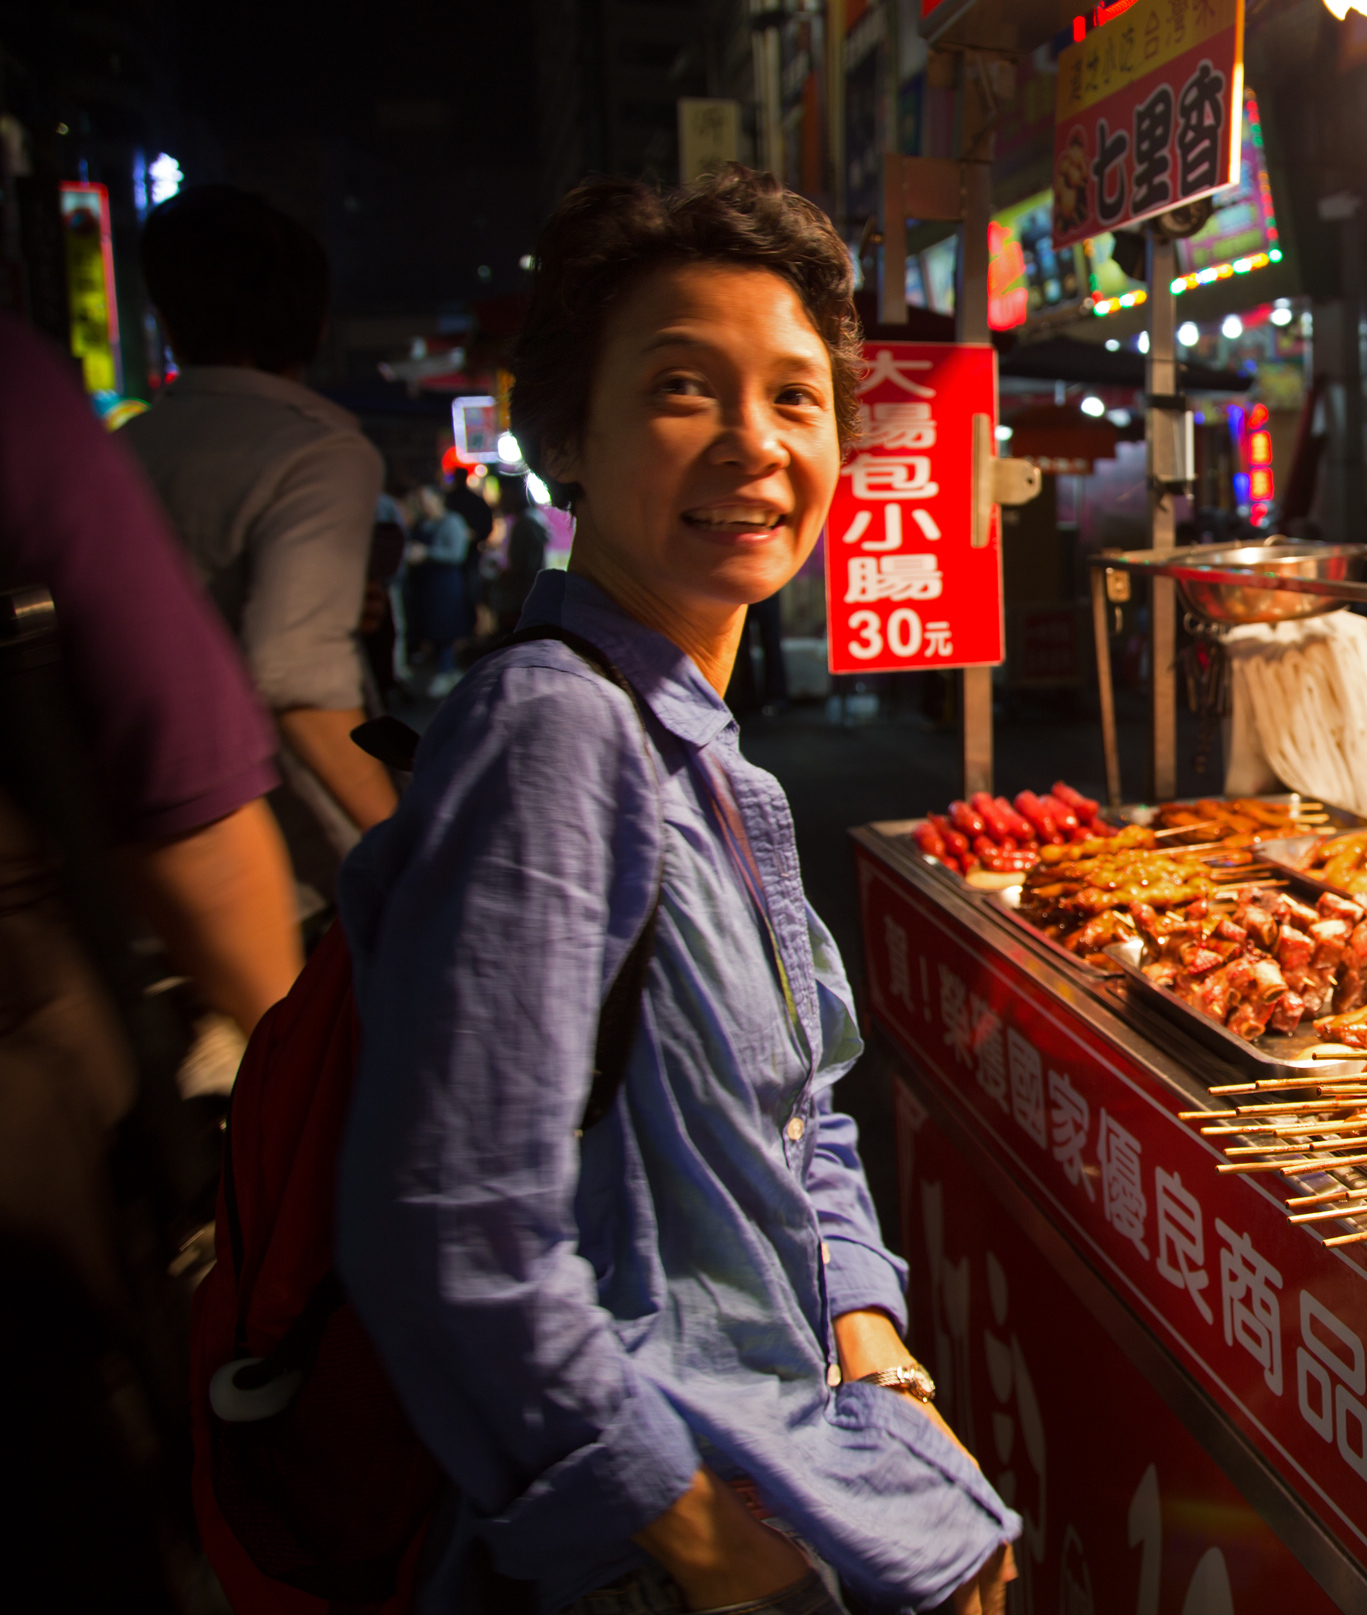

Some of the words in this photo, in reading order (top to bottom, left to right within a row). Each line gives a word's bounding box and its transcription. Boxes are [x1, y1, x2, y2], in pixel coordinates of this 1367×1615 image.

[1089, 58, 1226, 226] 七里香
[840, 349, 944, 604] 大腸包小腸
[848, 607, 953, 660] 30元
